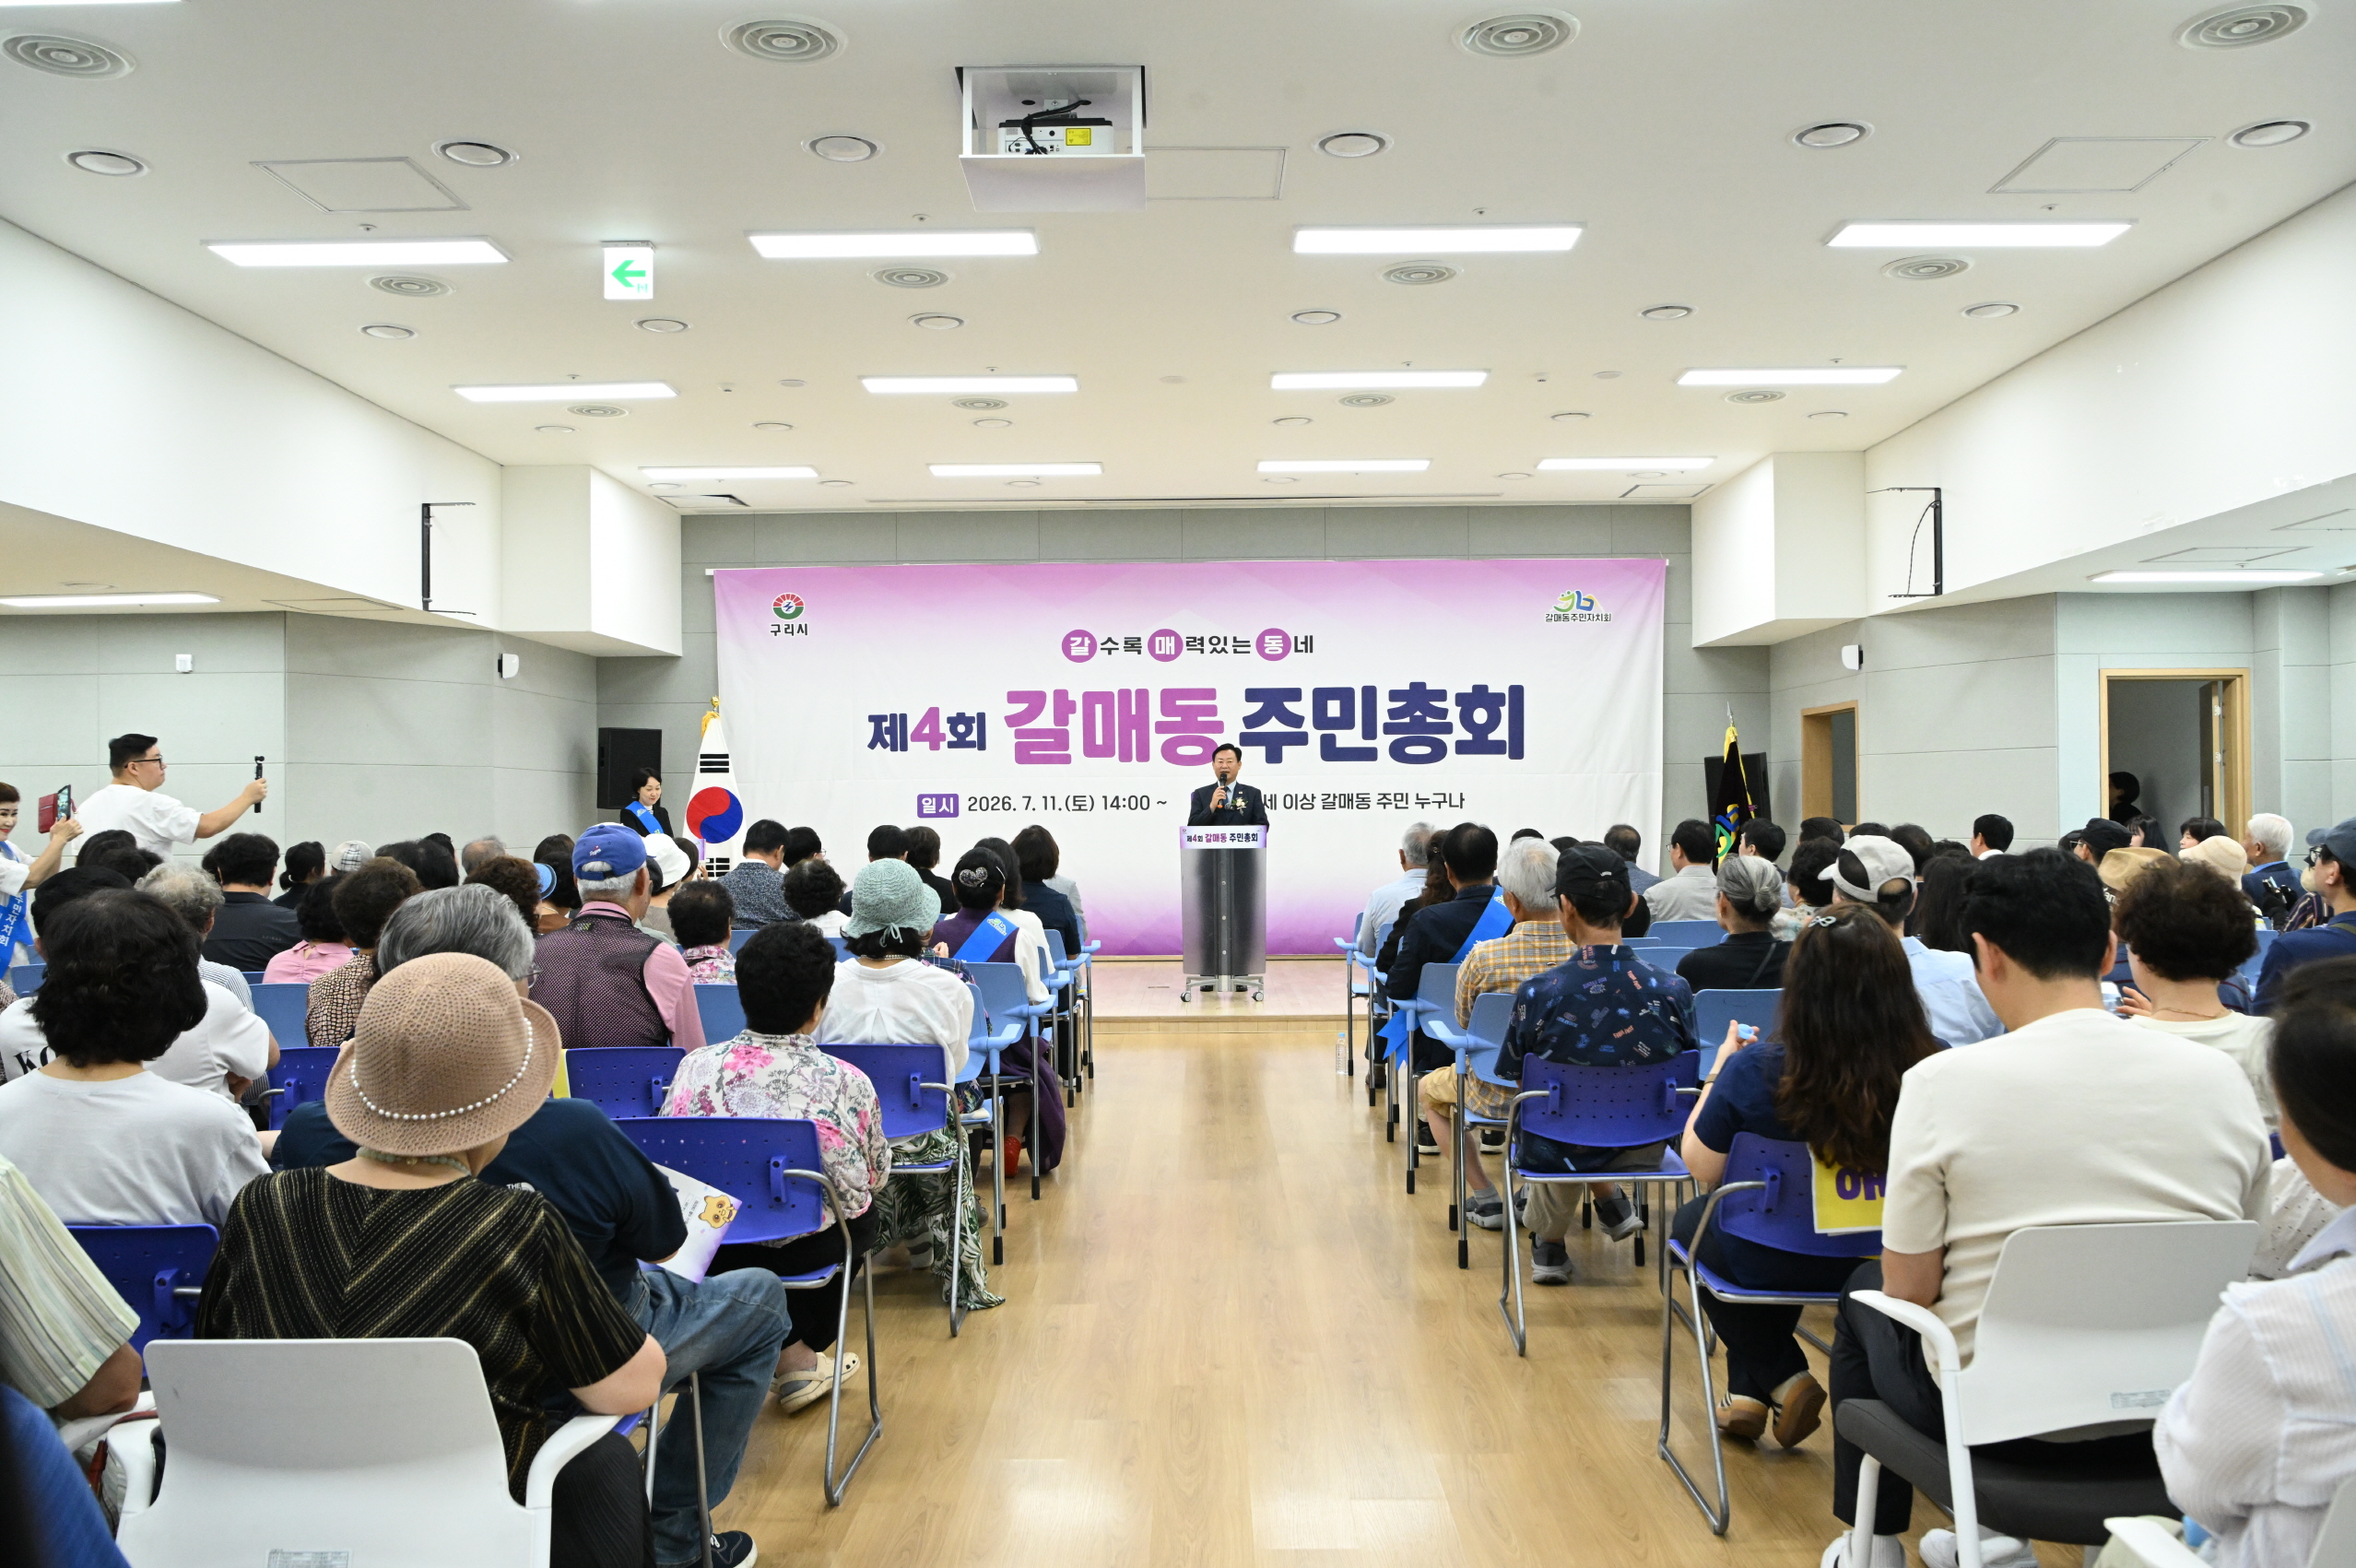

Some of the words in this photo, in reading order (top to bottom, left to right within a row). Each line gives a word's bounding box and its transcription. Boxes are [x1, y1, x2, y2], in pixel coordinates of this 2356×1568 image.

[1545, 613, 1611, 622] 갈매동주민자치회
[771, 623, 807, 636] 구리시
[1066, 633, 1142, 658] 갈수록
[1152, 633, 1251, 657] 매력있는
[1261, 633, 1313, 656] 동네
[867, 707, 986, 752] 제4회
[1004, 688, 1224, 766] 갈매동
[1239, 681, 1525, 764] 주민총회
[922, 797, 954, 814] 일시
[968, 796, 1017, 811] 2026.
[1022, 796, 1036, 811] 7.
[1102, 795, 1150, 810] 14:00
[1283, 793, 1316, 810] 이상
[1321, 793, 1372, 810] 갈매동
[1376, 793, 1408, 809] 주민
[1415, 792, 1465, 809] 누구나
[1186, 834, 1203, 843] 제4회
[1205, 833, 1227, 843] 갈매동
[1230, 832, 1258, 843] 주민총회
